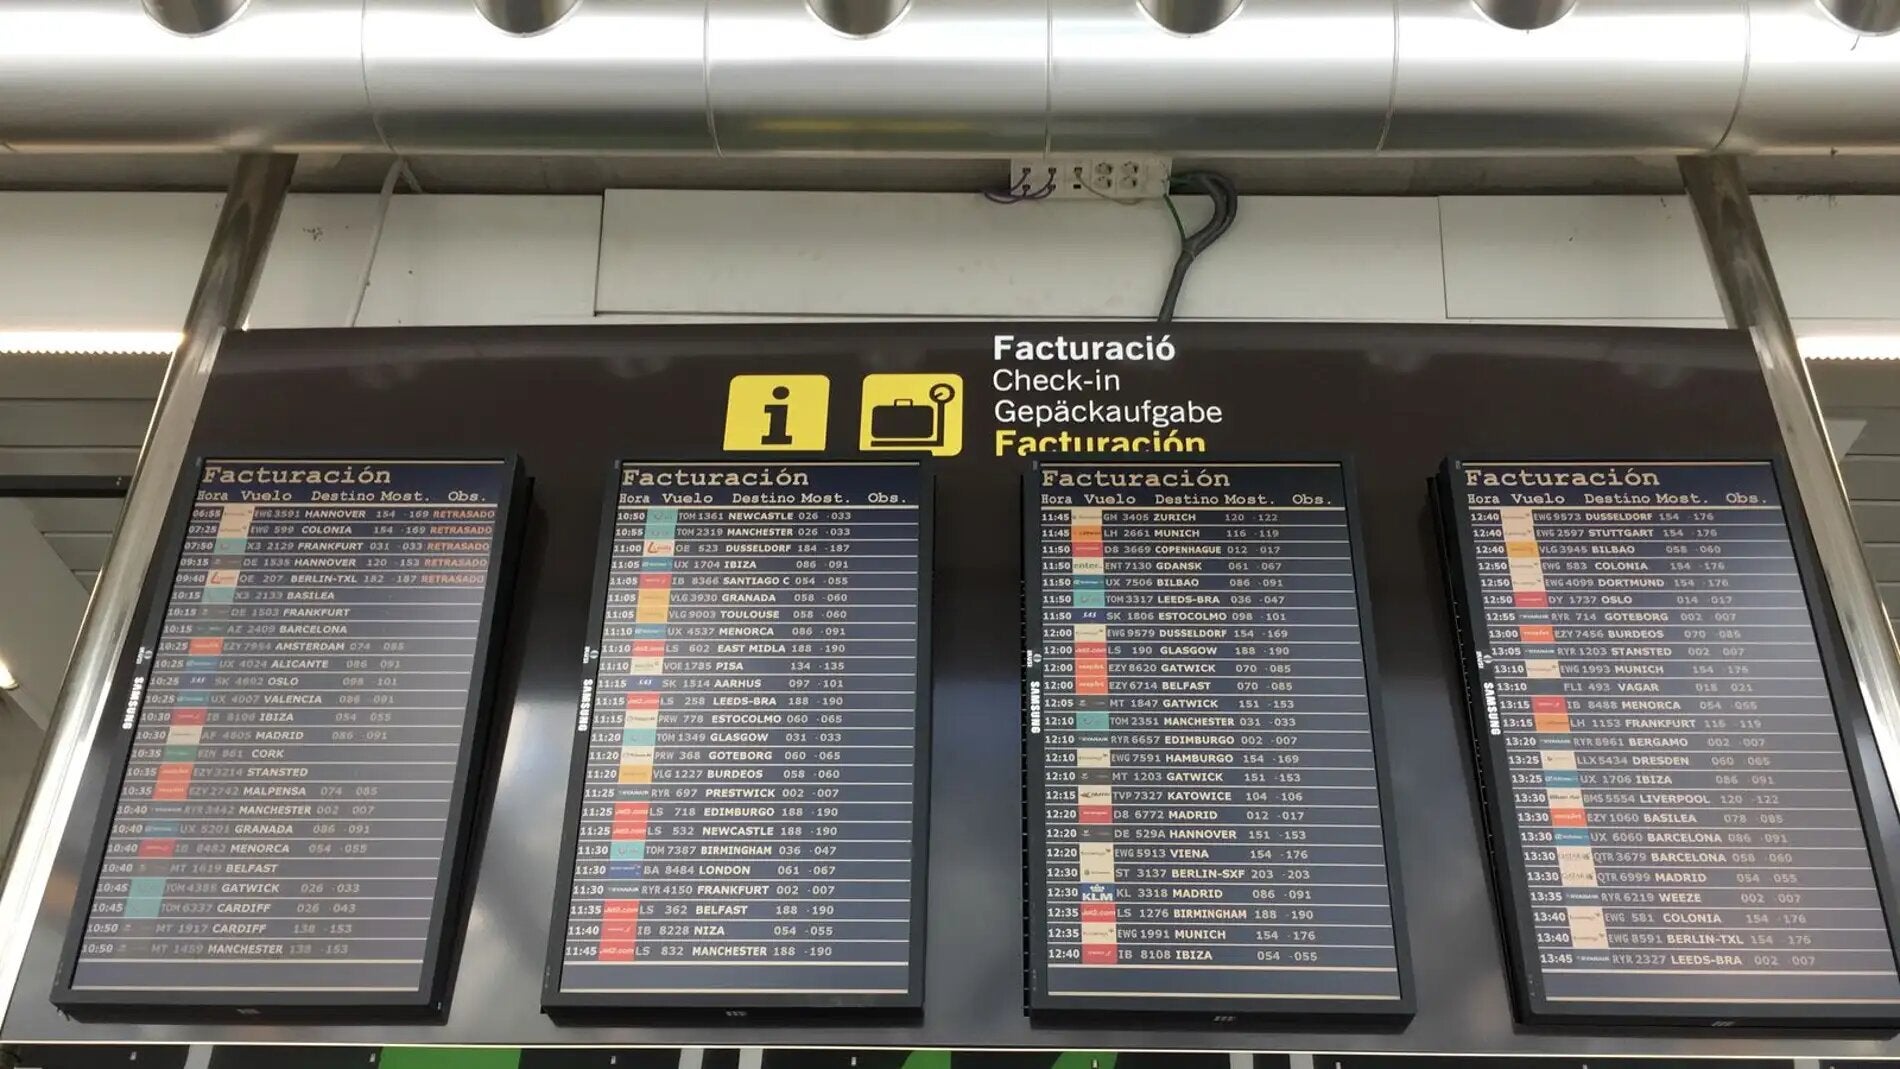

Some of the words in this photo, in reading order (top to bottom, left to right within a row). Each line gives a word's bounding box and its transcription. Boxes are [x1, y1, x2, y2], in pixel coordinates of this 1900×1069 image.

[994, 335, 1176, 361] Facturació
[993, 369, 1121, 391] Check-in
[994, 400, 1223, 427] Gepäckaufgabe
[202, 467, 392, 483] Facturación
[621, 470, 809, 485] Facturación
[1042, 471, 1230, 486] Facturación
[1464, 470, 1660, 485] Facturación
[196, 490, 229, 500] Hora
[239, 490, 293, 500] Vuelo
[310, 491, 375, 500] Destino
[379, 491, 430, 501] Most.
[447, 490, 486, 501] Obs.
[619, 493, 650, 503] Hora
[661, 492, 713, 503] Vuelo
[732, 493, 795, 503] Destino
[801, 493, 849, 503] Most.
[867, 492, 905, 502] Obs.
[1041, 494, 1072, 504] Hora
[1084, 493, 1135, 504] Vuelo
[1155, 494, 1219, 504] Destino
[1224, 494, 1273, 504] Most.
[1292, 494, 1330, 504] Obs.
[1467, 494, 1500, 503] Hora
[1510, 493, 1565, 503] Vuelo
[1583, 493, 1651, 503] Destino
[1655, 493, 1708, 503] Most.
[1724, 492, 1766, 503] Obs.
[430, 526, 492, 534] RETRASADO
[725, 544, 790, 552] DUSSELDORF
[1591, 545, 1635, 553] BILBAO
[294, 558, 356, 566] HANNOVER
[1157, 578, 1198, 586] BILBAO
[286, 591, 335, 599] BASILEA
[1157, 595, 1220, 603] LEEDS-BRA
[283, 608, 350, 616] FRANKFURT
[720, 610, 779, 618] TOULOUSE
[1158, 612, 1227, 620] ESTOCOLMO
[279, 625, 347, 633] BARCELONA
[719, 627, 774, 635] MENORCA
[1159, 629, 1226, 637] DUSSELDORF
[1607, 630, 1664, 638] BURDEOS
[275, 642, 345, 650] AMSTERDAM
[717, 644, 745, 652] EAST
[749, 644, 785, 652] MIDLA
[1160, 646, 1217, 654] GLASGOW
[1611, 647, 1672, 655] STANSTED
[715, 662, 743, 670] PISA
[1160, 664, 1215, 672] GATWICK
[1614, 665, 1664, 673] MUNICH
[267, 677, 299, 685] OSLO
[714, 679, 761, 687] AARHUS
[1162, 681, 1211, 689] BELFAST
[1617, 683, 1659, 691] VAGAR
[122, 677, 144, 729] SAMSUNG
[263, 695, 322, 703] VALENCIA
[713, 697, 776, 705] LEEDS-BRA
[1163, 699, 1217, 707] GATWICK
[578, 679, 593, 731] SAMSUNG
[1031, 681, 1041, 734] SAMSUNG
[1483, 682, 1501, 735] SAMSUNG
[1621, 701, 1680, 709] MENORCA
[259, 713, 294, 721] IBIZA
[711, 714, 781, 723] ESTOCOLMO
[1164, 717, 1234, 725] MANCHESTER
[1625, 719, 1696, 727] FRANKFURT
[255, 731, 304, 739] MADRID
[709, 733, 768, 741] GLASGOW
[1165, 735, 1234, 744] EDIMBURGO
[1628, 738, 1688, 746] BERGAMO
[250, 749, 284, 758] CORK
[708, 751, 772, 759] GOTEBORG
[1165, 753, 1233, 762] HAMBURGO
[1632, 756, 1689, 765] DRESDEN
[246, 768, 308, 776] STANSTED
[707, 769, 762, 778] BURDEOS
[1046, 771, 1075, 780] 12:10
[1166, 772, 1222, 781] GATWICK
[1635, 775, 1672, 783] IBIZA
[243, 787, 306, 795] MALPENSA
[705, 788, 775, 797] PRESTWICK
[1046, 791, 1075, 799] 12:15
[1167, 791, 1231, 800] KATOWICE
[1639, 794, 1710, 803] LIVERPOOL
[238, 806, 312, 814] MANCHESTER
[704, 807, 774, 816] EDIMBURGO
[1047, 809, 1076, 818] 12:20
[1168, 810, 1217, 819] MADRID
[1643, 814, 1697, 822] BASILEA
[234, 825, 294, 833] GRANADA
[702, 827, 773, 835] NEWCASTLE
[1047, 828, 1076, 837] 12:20
[1169, 829, 1236, 838] HANNOVER
[1646, 833, 1722, 842] BARCELONA
[230, 844, 290, 852] MENORCA
[701, 846, 771, 854] BIRMINGHAM
[1047, 848, 1077, 857] 12:20
[1170, 849, 1208, 858] VIENA
[1651, 853, 1726, 861] BARCELONA
[225, 864, 278, 872] BELFAST
[699, 866, 750, 874] LONDON
[1047, 868, 1077, 876] 12:30
[1171, 868, 1245, 878] BERLIN-SXF
[1654, 873, 1707, 882] MADRID
[220, 884, 280, 892] GATWICK
[697, 885, 769, 894] FRANKFURT
[1048, 887, 1078, 896] 12:30
[1082, 893, 1113, 901] KLM
[1172, 889, 1222, 898] MADRID
[1658, 893, 1701, 902] WEEZE
[216, 903, 271, 912] CARDIFF
[695, 905, 747, 914] BELFAST
[1048, 907, 1078, 917] 12:35
[1173, 909, 1246, 918] BIRMINGHAM
[1662, 913, 1721, 922] COLONIA
[211, 924, 266, 933] CARDIFF
[694, 926, 724, 934] NIZA
[1048, 928, 1078, 937] 12:35
[1175, 929, 1225, 939] MUNICH
[1666, 934, 1744, 943] BERLIN-TXL
[207, 944, 283, 953] MANCHESTER
[692, 946, 767, 955] MANCHESTER
[1049, 949, 1079, 958] 12:40
[1176, 950, 1212, 959] IBIZA
[1671, 955, 1742, 964] LEEDS-BRA
